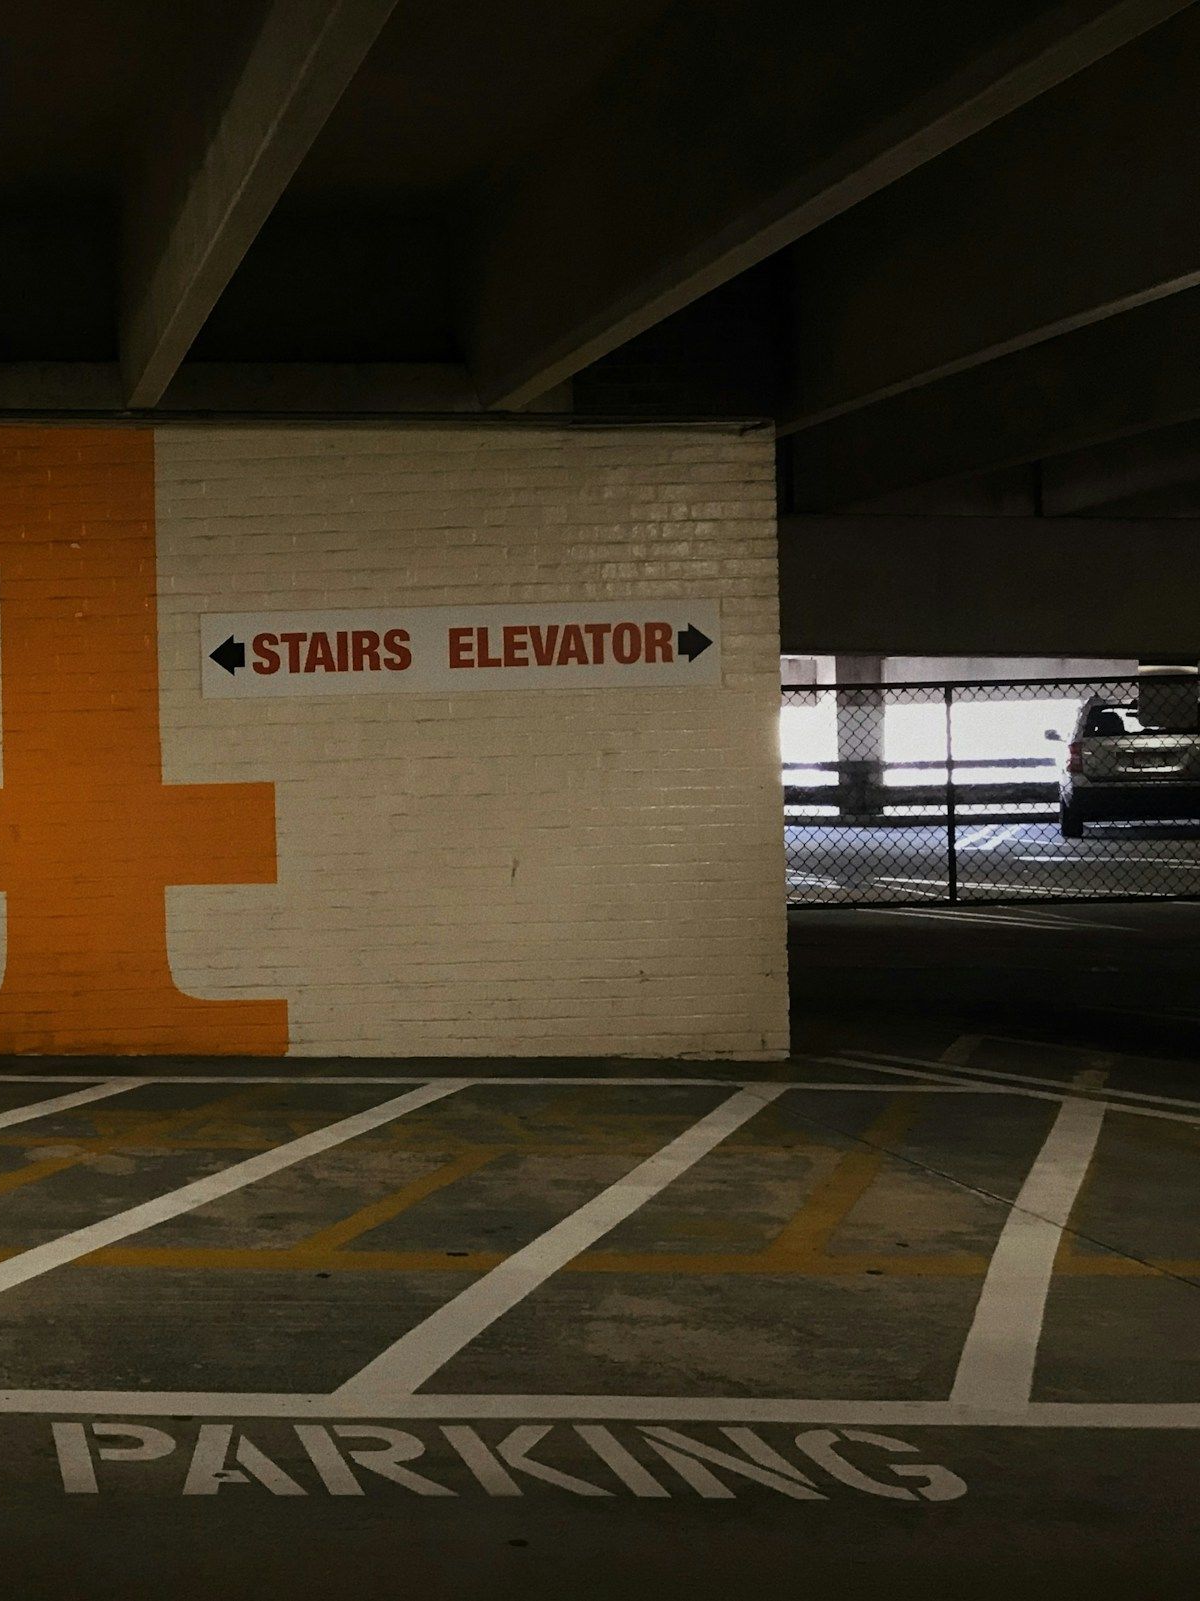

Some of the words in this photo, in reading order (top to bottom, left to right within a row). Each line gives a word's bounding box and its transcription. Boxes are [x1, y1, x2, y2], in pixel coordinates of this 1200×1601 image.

[251, 629, 412, 675] STAIRS
[448, 621, 674, 669] ELEVATOR
[51, 1421, 968, 1501] PARKING
